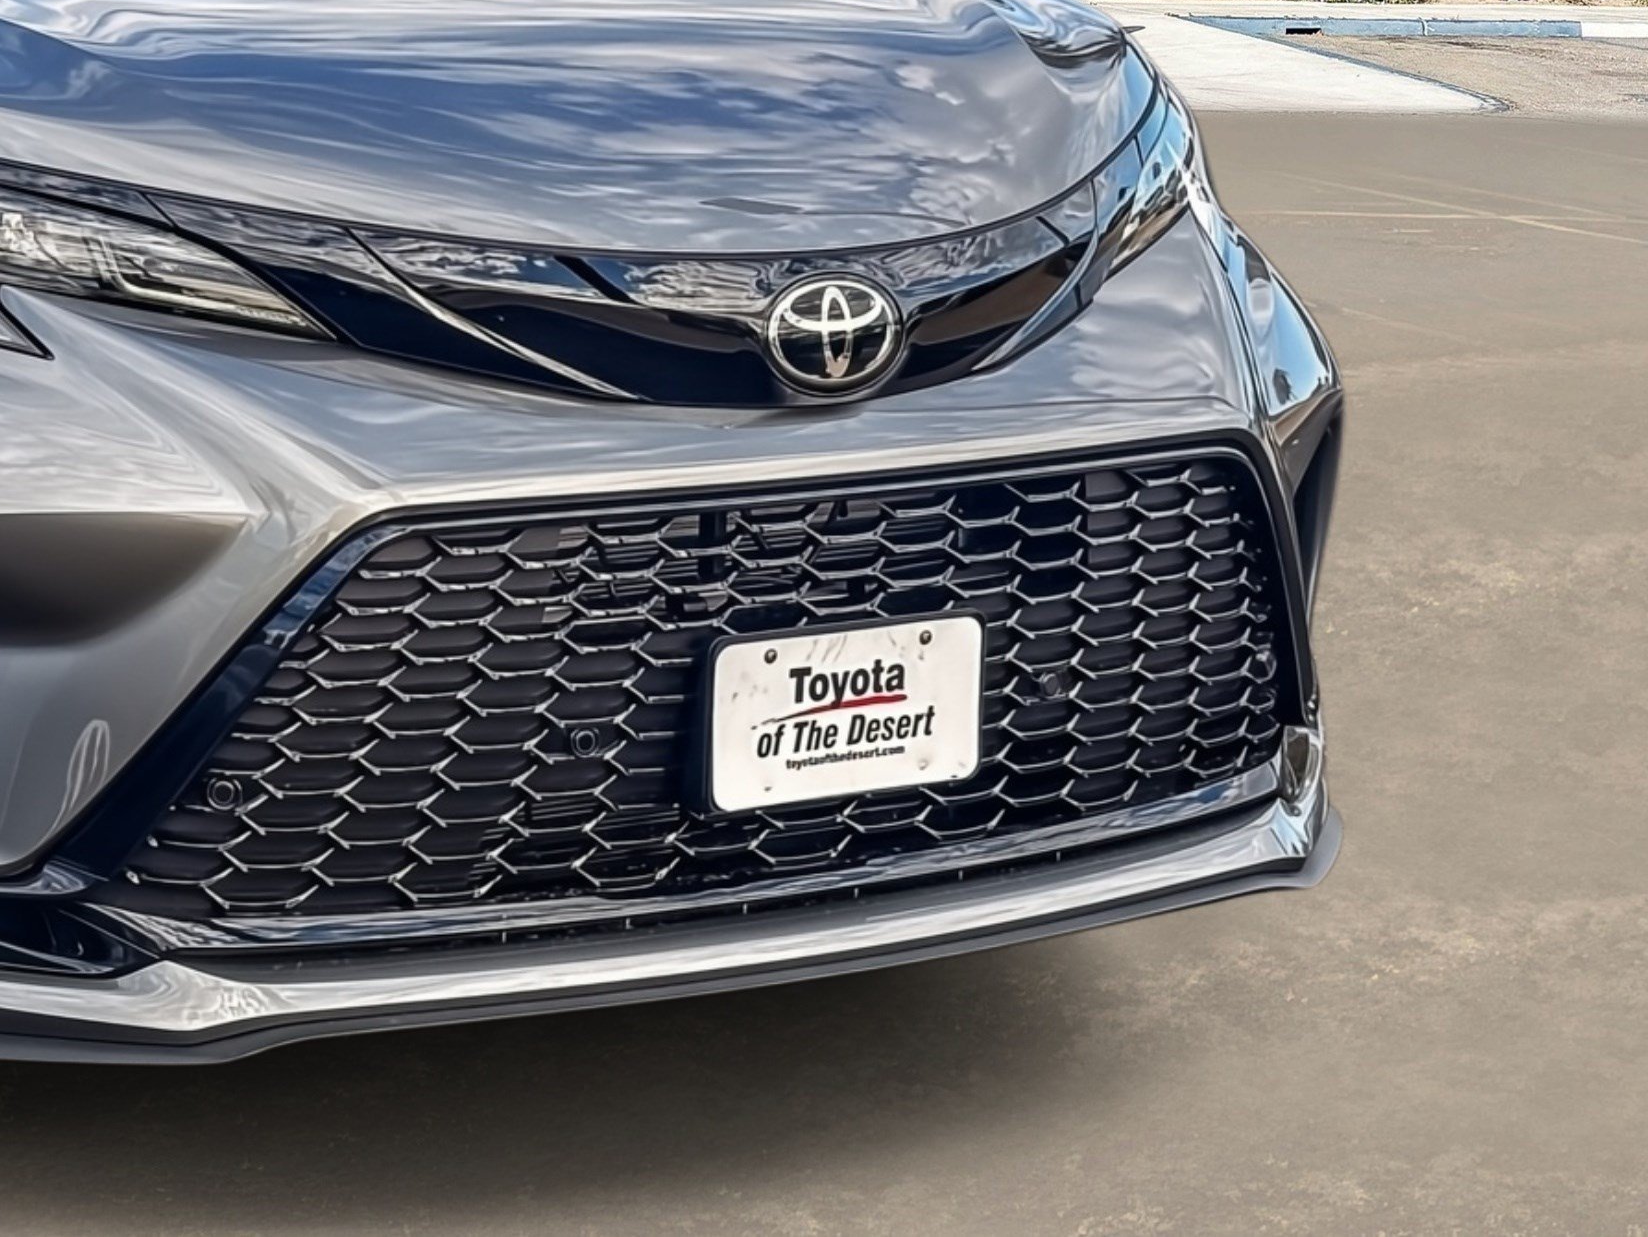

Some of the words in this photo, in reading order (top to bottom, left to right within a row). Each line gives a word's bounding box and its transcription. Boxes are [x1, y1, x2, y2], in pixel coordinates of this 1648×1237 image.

[789, 659, 905, 707] Toyota
[757, 723, 784, 758] of
[791, 719, 838, 754] The
[847, 705, 934, 746] Desert
